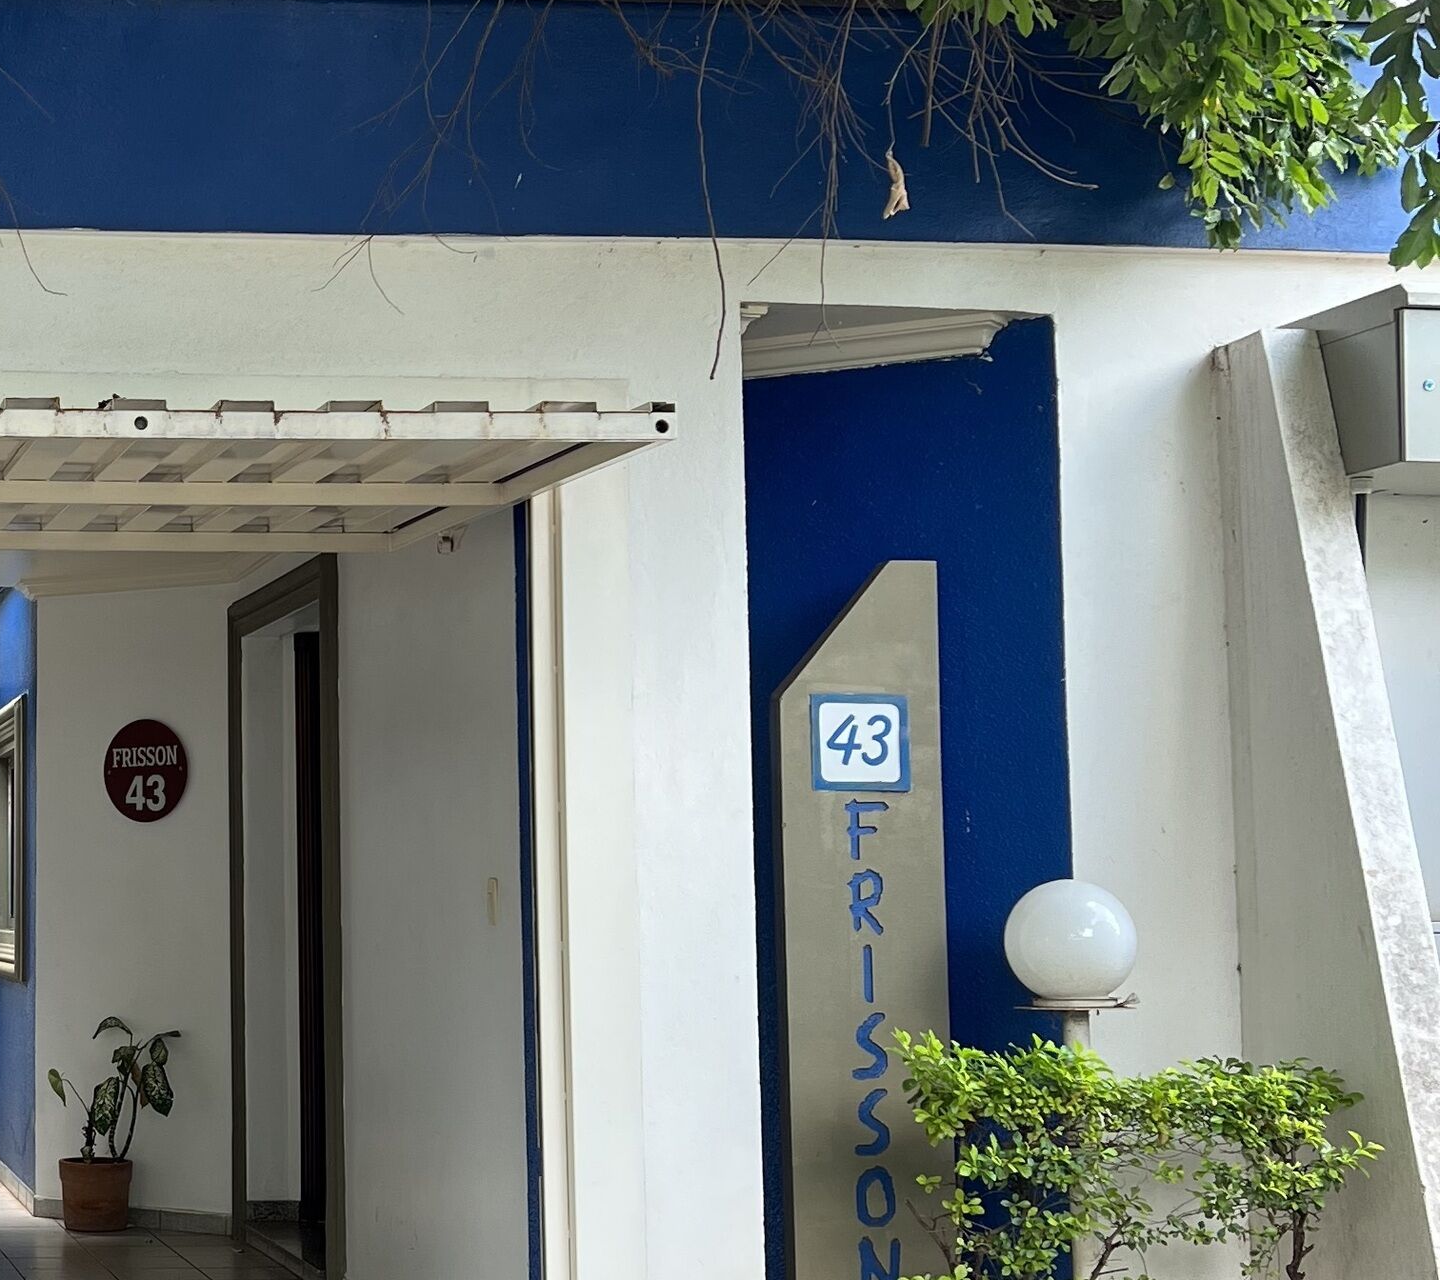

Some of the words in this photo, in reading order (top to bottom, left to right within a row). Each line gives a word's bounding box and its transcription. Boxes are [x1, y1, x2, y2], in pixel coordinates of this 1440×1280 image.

[111, 744, 178, 769] FRISSON
[825, 713, 893, 767] 43
[124, 773, 167, 812] 43
